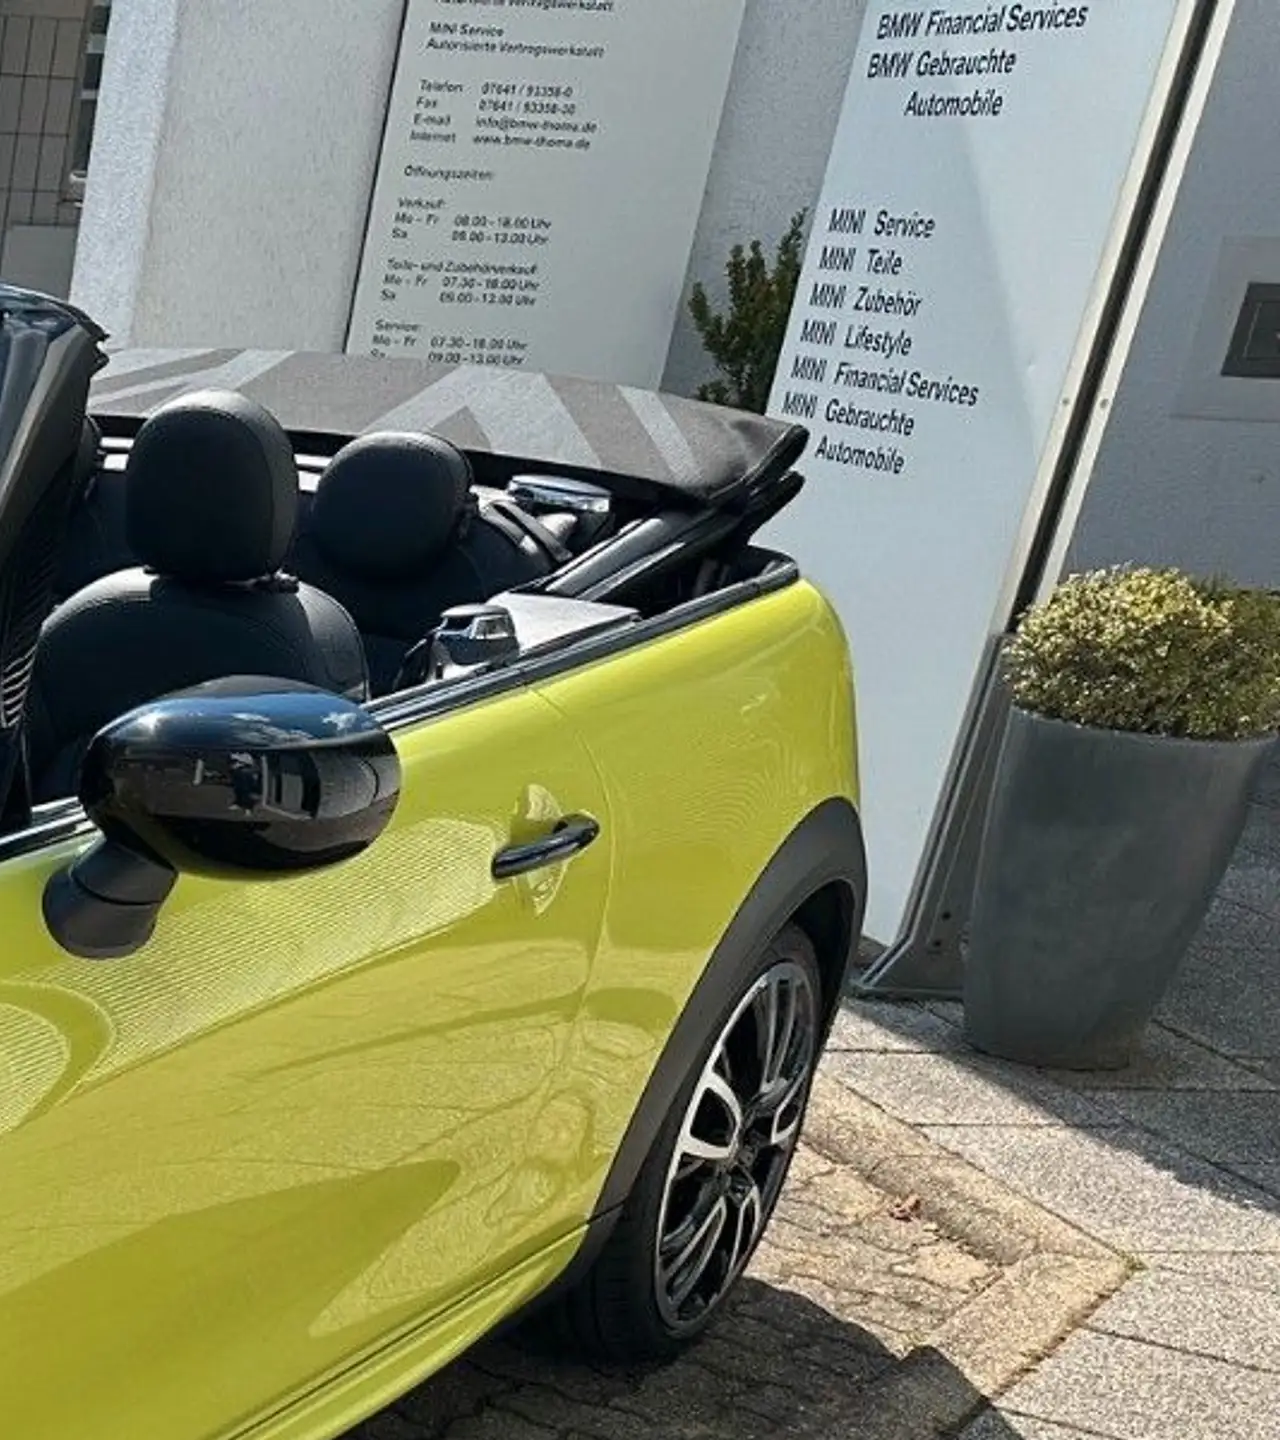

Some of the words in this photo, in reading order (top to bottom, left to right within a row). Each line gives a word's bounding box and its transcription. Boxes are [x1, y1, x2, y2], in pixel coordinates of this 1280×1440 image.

[459, 23, 504, 37] Service
[877, 11, 924, 40] BMW
[925, 6, 1005, 37] Financial
[1006, 2, 1089, 33] Services
[867, 51, 914, 79] BMW
[915, 48, 1017, 78] Gebrauchte
[904, 89, 1004, 117] Automobile
[828, 208, 866, 235] MINI
[874, 209, 936, 238] Service
[819, 246, 856, 272] MINI
[867, 248, 902, 276] Teile
[809, 283, 847, 309] MINI
[853, 286, 923, 316] Zubehör
[800, 319, 837, 346] MINI
[844, 323, 912, 359] Lifestyle
[791, 355, 827, 383] MINI
[833, 361, 907, 395] Financial
[907, 371, 980, 406] Services
[781, 391, 818, 419] MINI
[825, 398, 915, 436] Gebrauchte
[814, 434, 905, 474] Automobile
